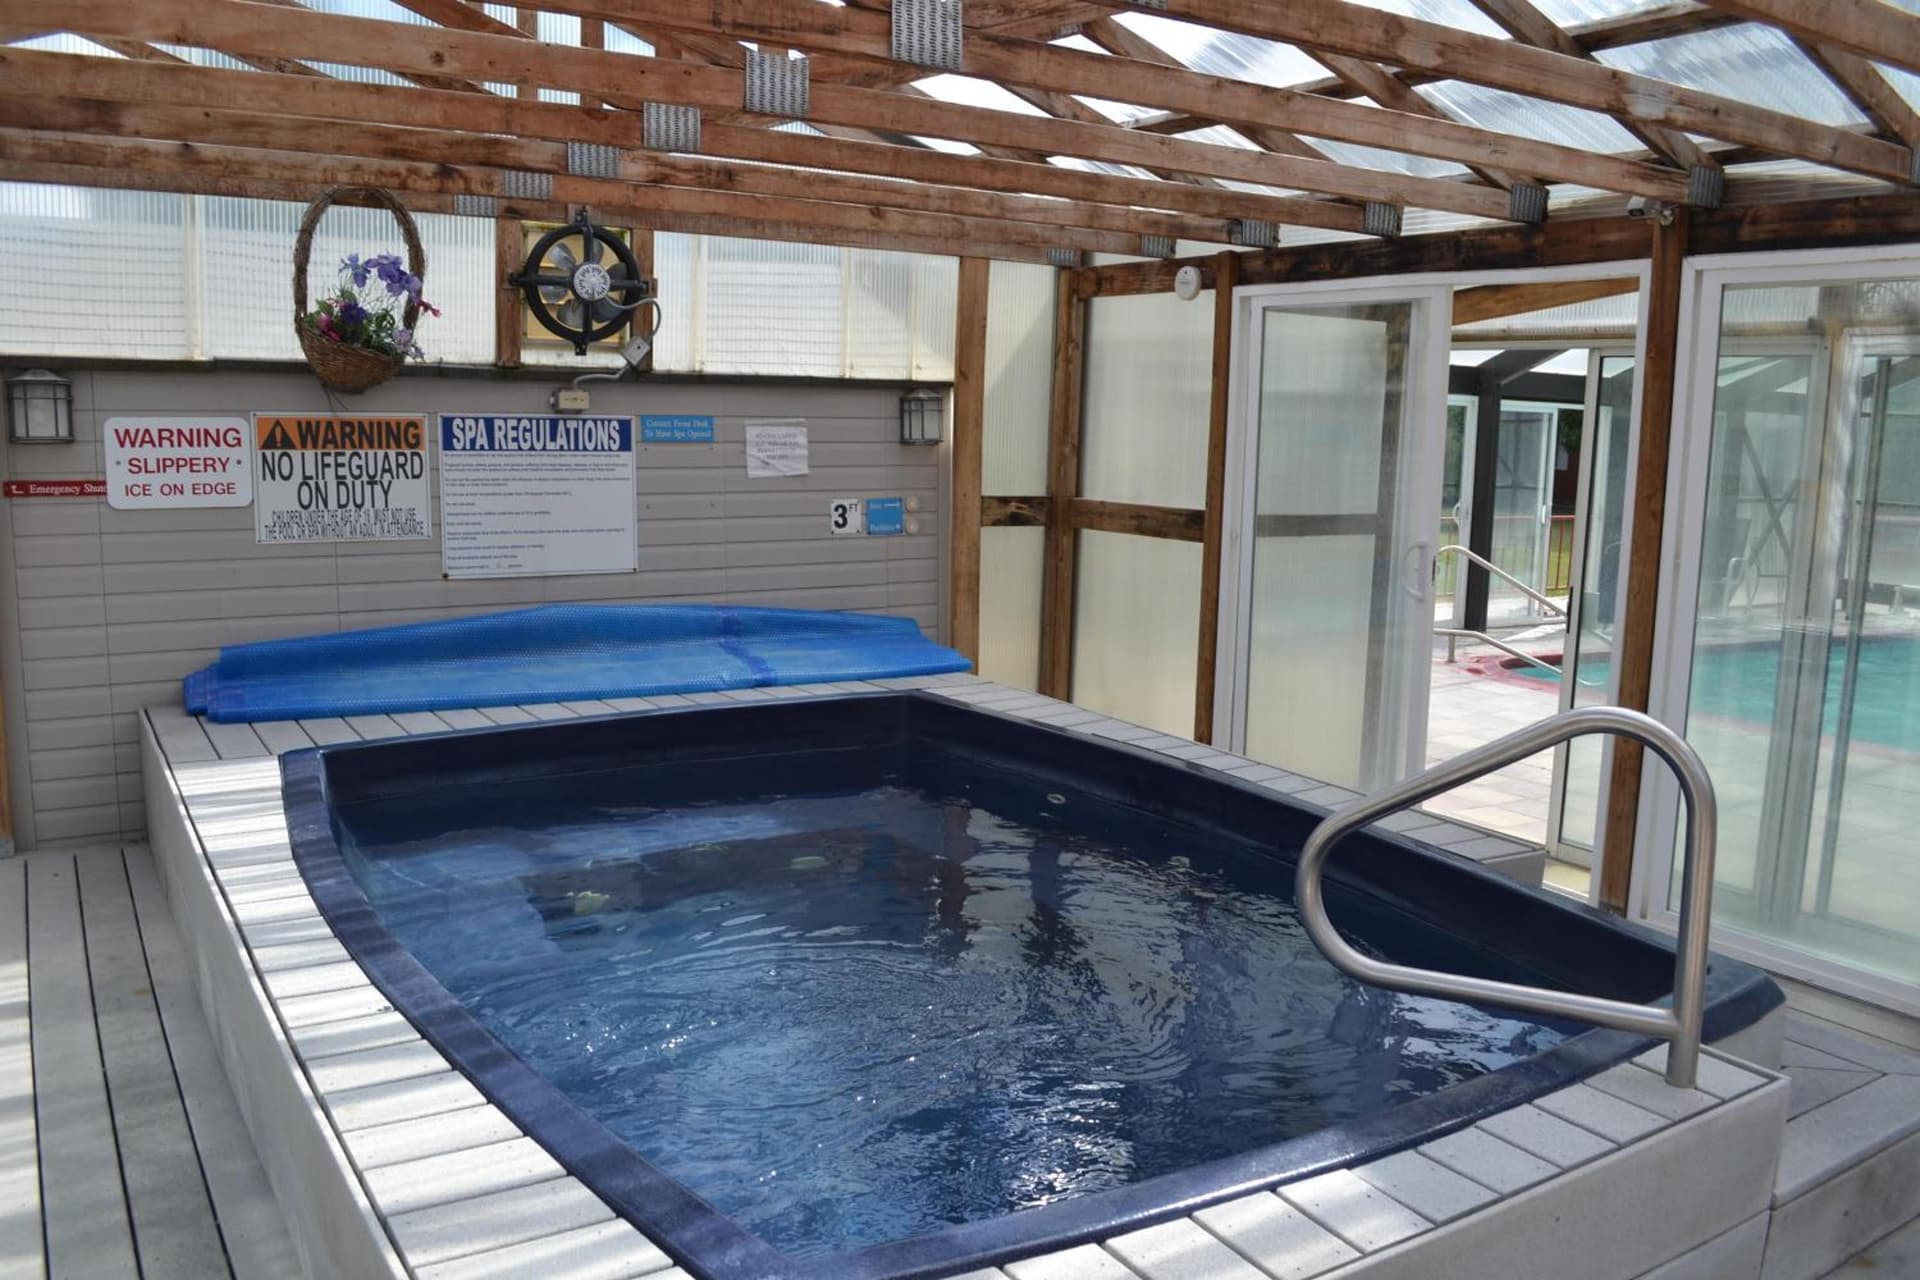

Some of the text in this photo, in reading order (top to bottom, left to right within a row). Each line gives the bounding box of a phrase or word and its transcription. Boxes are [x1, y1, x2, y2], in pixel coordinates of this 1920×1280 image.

[114, 428, 242, 448] WARNING
[298, 421, 420, 449] WARNING
[452, 418, 621, 450] SPA REGULATIONS
[128, 458, 230, 474] SLIPPERY
[262, 452, 424, 481] NO LIFEGUARD
[29, 484, 80, 496] Emergency
[124, 483, 237, 497] ICE ON EDGE
[297, 480, 393, 510] ON DUTY
[272, 510, 302, 525] CHILDREN
[304, 509, 326, 524] UNDER
[328, 509, 339, 524] THE
[341, 509, 353, 524] AGE
[373, 508, 389, 523] MUST
[390, 508, 403, 522] NOT
[404, 508, 416, 522] USE
[834, 504, 858, 529] 3 FT
[265, 525, 277, 539] THE
[279, 525, 295, 539] POOL
[308, 524, 319, 538] SPA
[321, 523, 347, 538] WITHOUT
[359, 523, 376, 537] ADULT
[386, 521, 425, 536] ATTENDANCE
